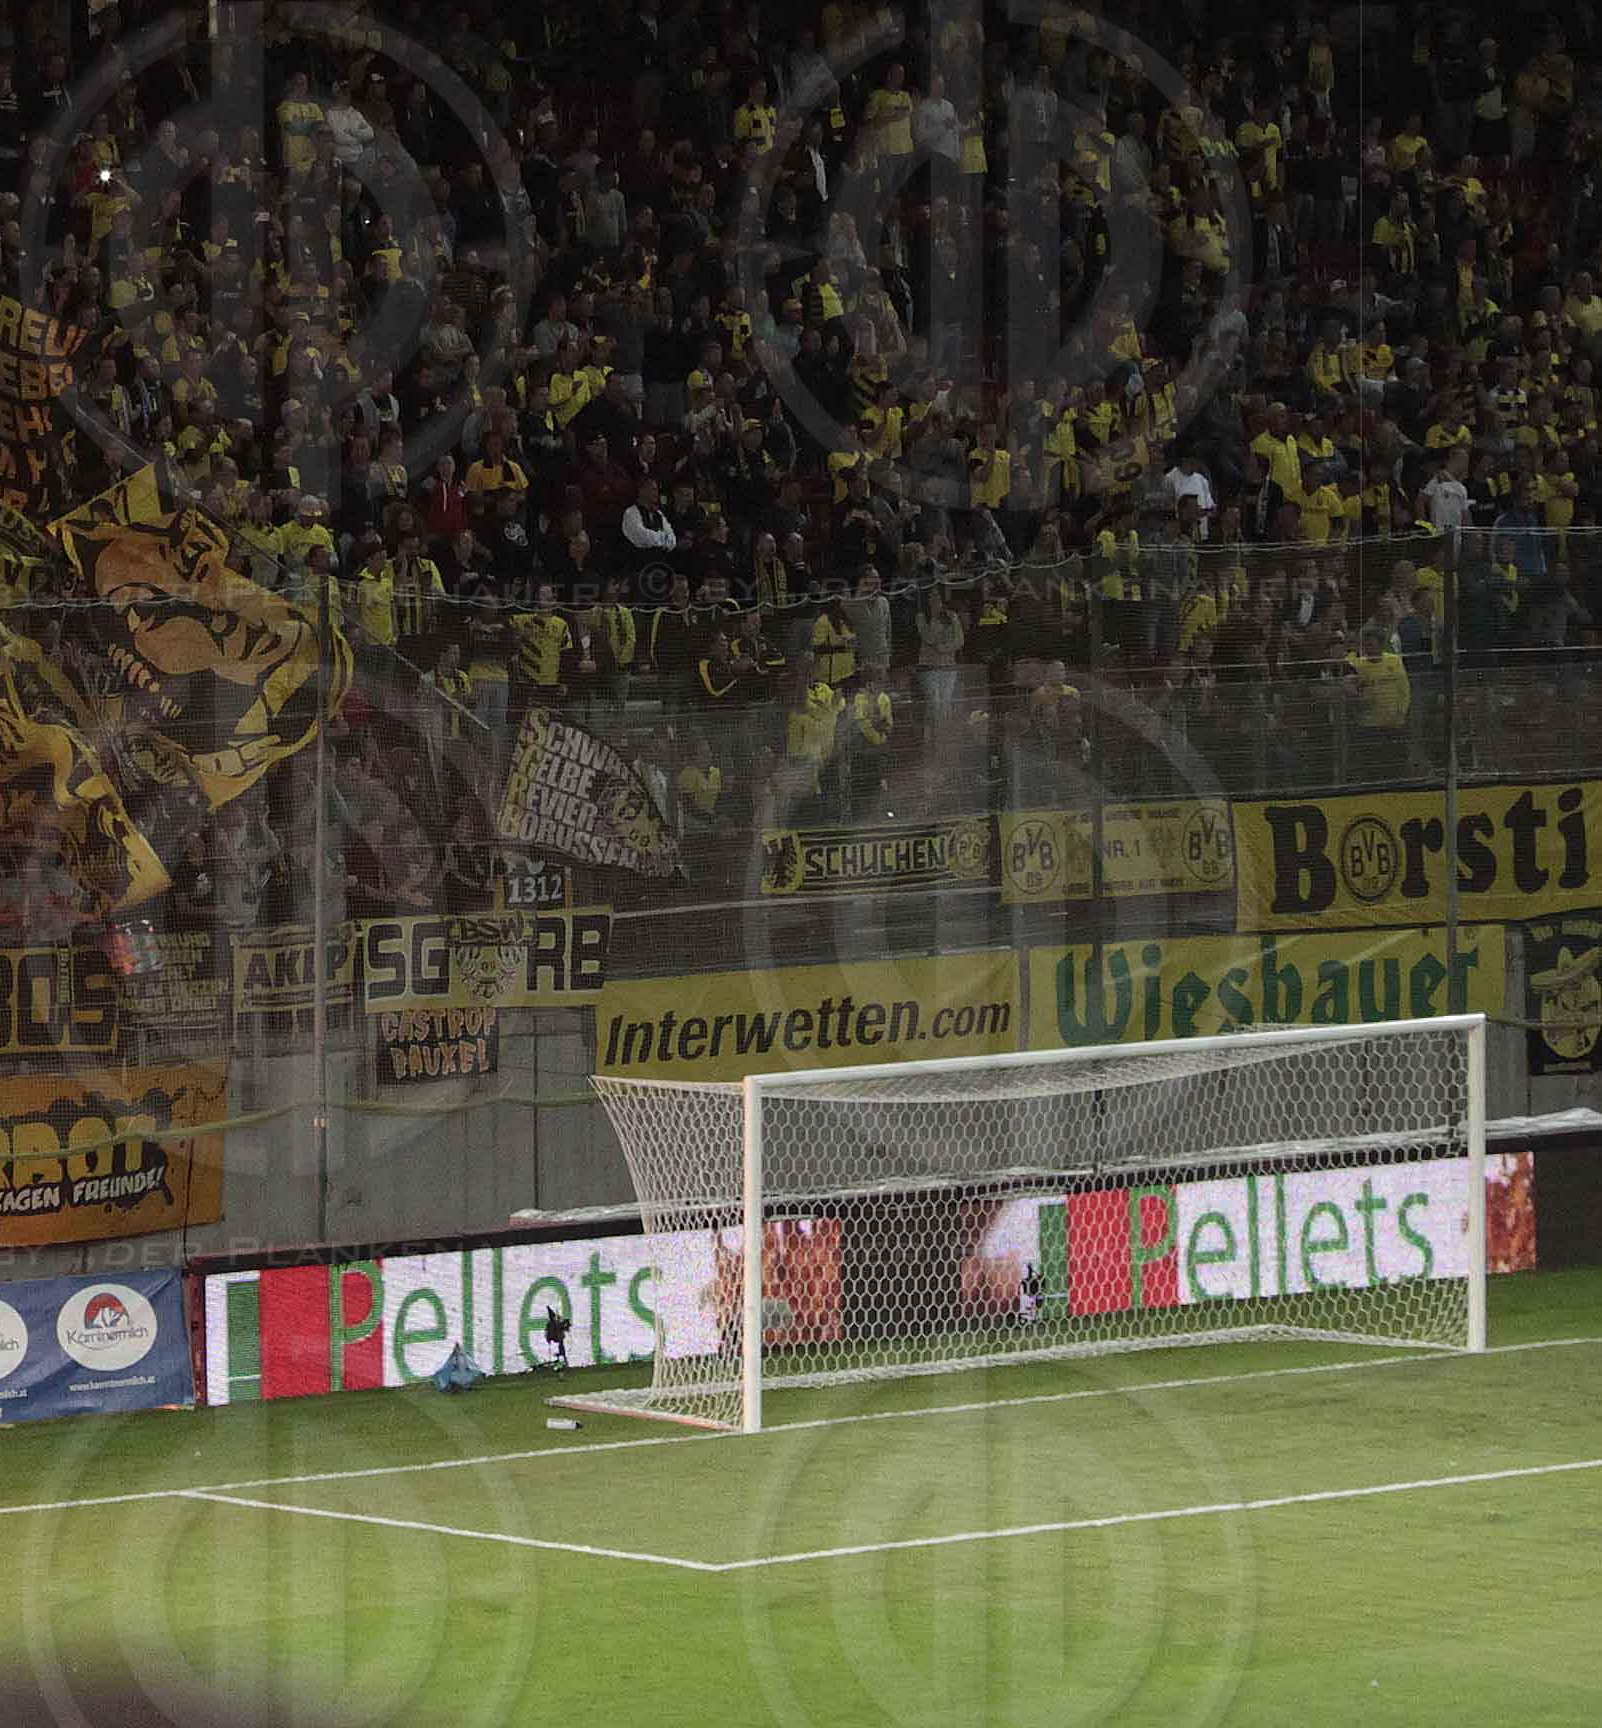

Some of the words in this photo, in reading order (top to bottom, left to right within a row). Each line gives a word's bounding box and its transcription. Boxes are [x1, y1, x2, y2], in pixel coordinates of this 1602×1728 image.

[508, 875, 564, 904] 1312
[604, 994, 1011, 1067] Interwetten.com
[1054, 935, 1479, 1048] Wiesbauer
[71, 1166, 165, 1206] FREUNDE!
[1129, 1172, 1434, 1310] Pellets
[331, 1248, 661, 1393] Pellets
